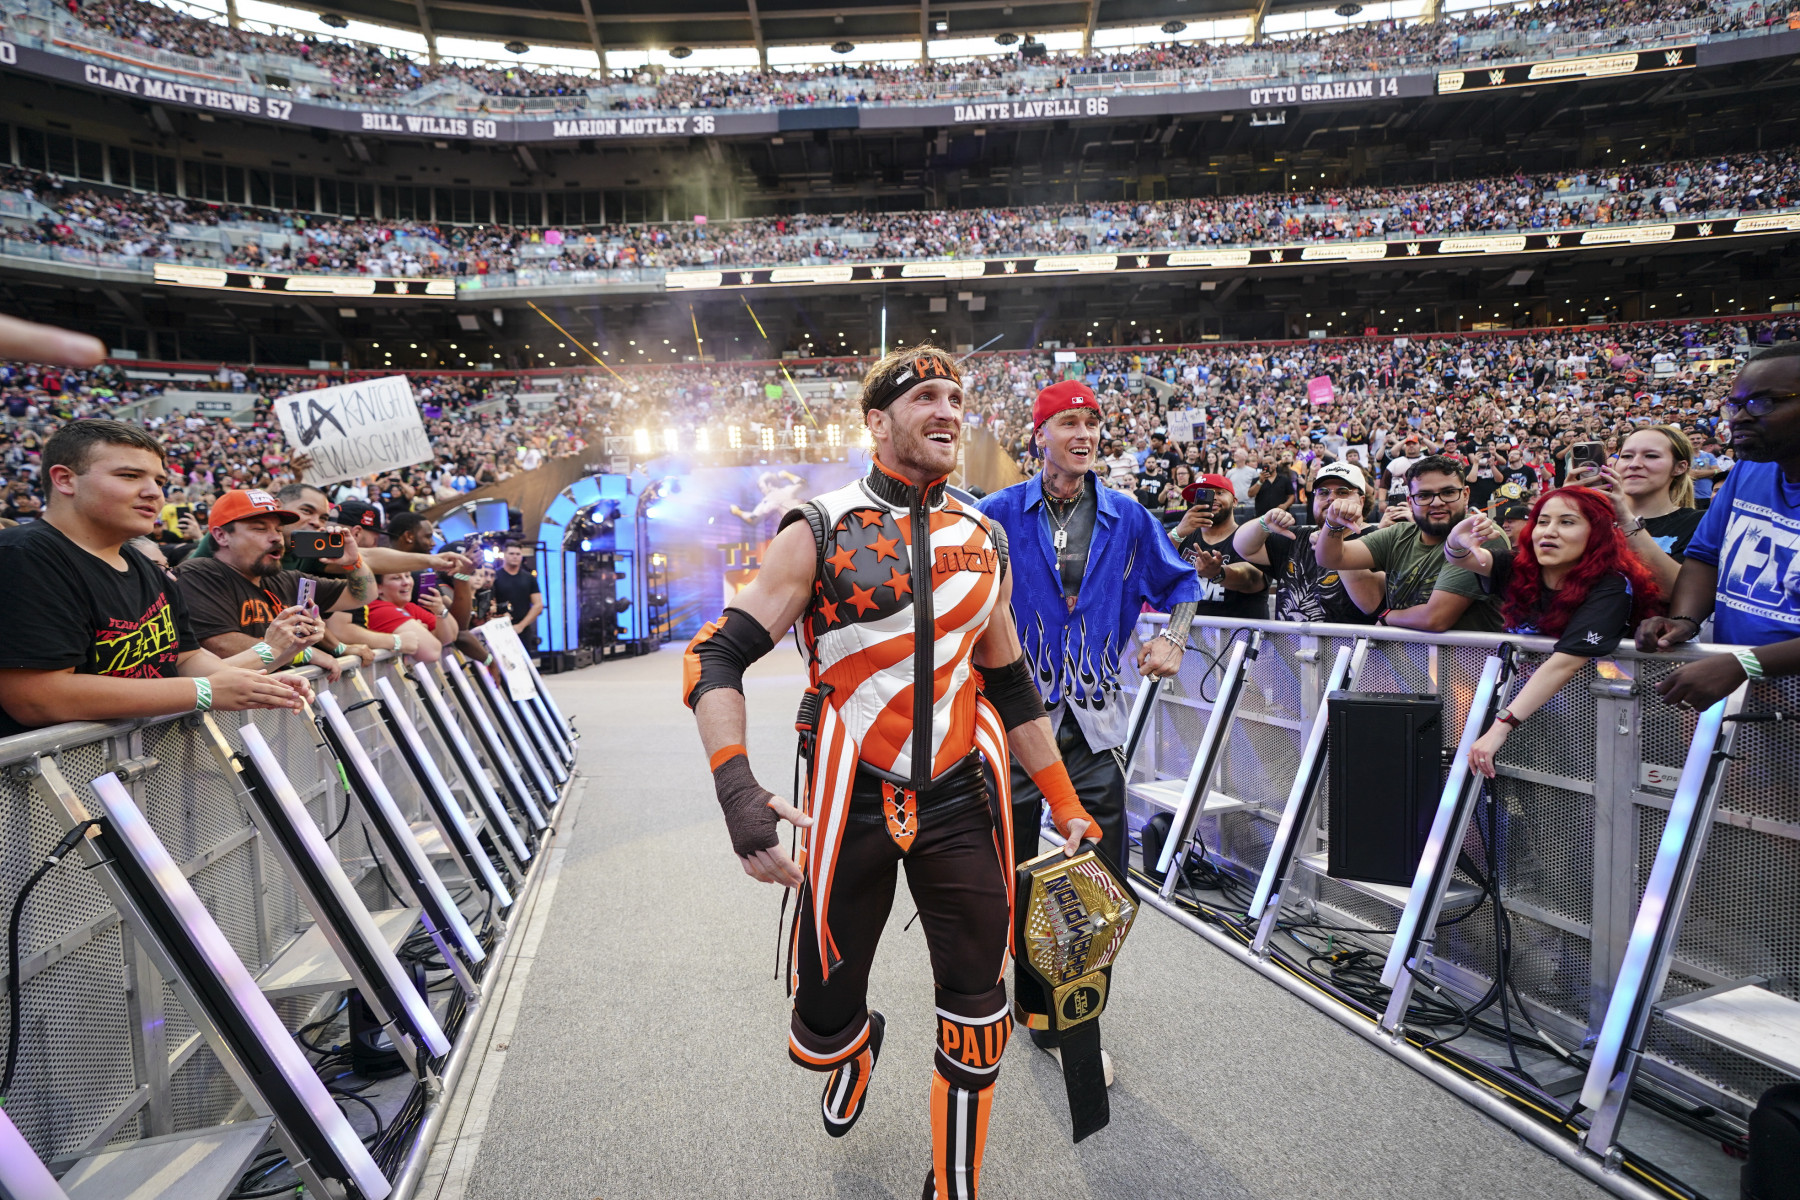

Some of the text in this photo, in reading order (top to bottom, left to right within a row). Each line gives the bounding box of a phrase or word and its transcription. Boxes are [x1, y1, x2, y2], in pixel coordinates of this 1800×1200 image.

[84, 64, 292, 121] CLAY MATTHEWS 57
[1250, 77, 1399, 105] OTTO GRAHAM 14
[954, 97, 1109, 122] DANTE LAVELLI 86
[361, 113, 497, 139] BILL WILLIS 60
[553, 115, 715, 138] MARION MOTLEY 36
[288, 381, 413, 447] LA KNIGHT
[1174, 411, 1189, 423] LA
[301, 426, 425, 484] NEW US CHAMP
[1043, 873, 1094, 983] CHAMPION
